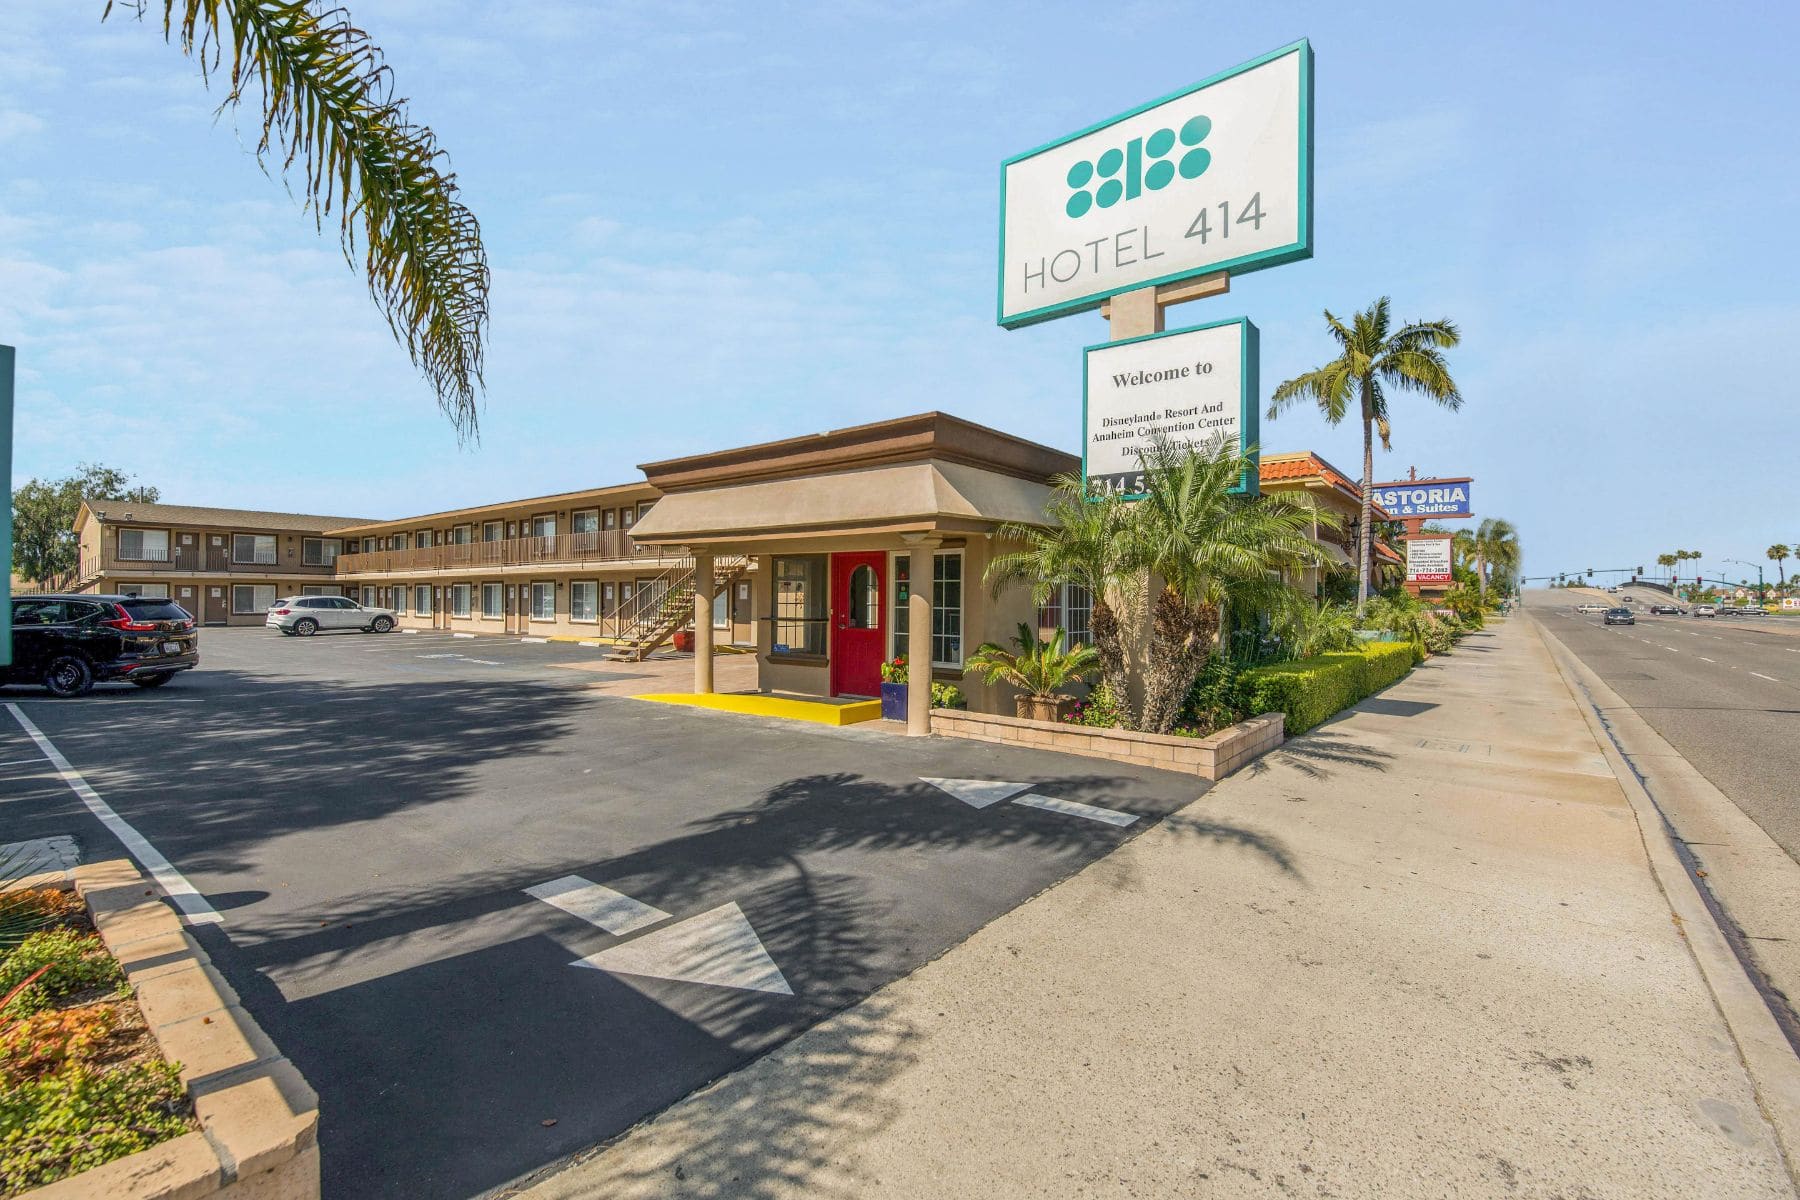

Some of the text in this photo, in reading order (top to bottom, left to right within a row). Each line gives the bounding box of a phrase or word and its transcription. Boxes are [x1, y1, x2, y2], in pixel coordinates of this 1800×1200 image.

[1024, 191, 1267, 293] HOTEL 414
[1112, 361, 1213, 388] Welcome to
[1165, 407, 1198, 419] Resort
[1201, 402, 1223, 413] And
[1092, 416, 1235, 442] Anaheim Convention Center
[1372, 487, 1467, 506] ASTORIA
[1402, 505, 1414, 514] &
[1416, 504, 1458, 513] Suites
